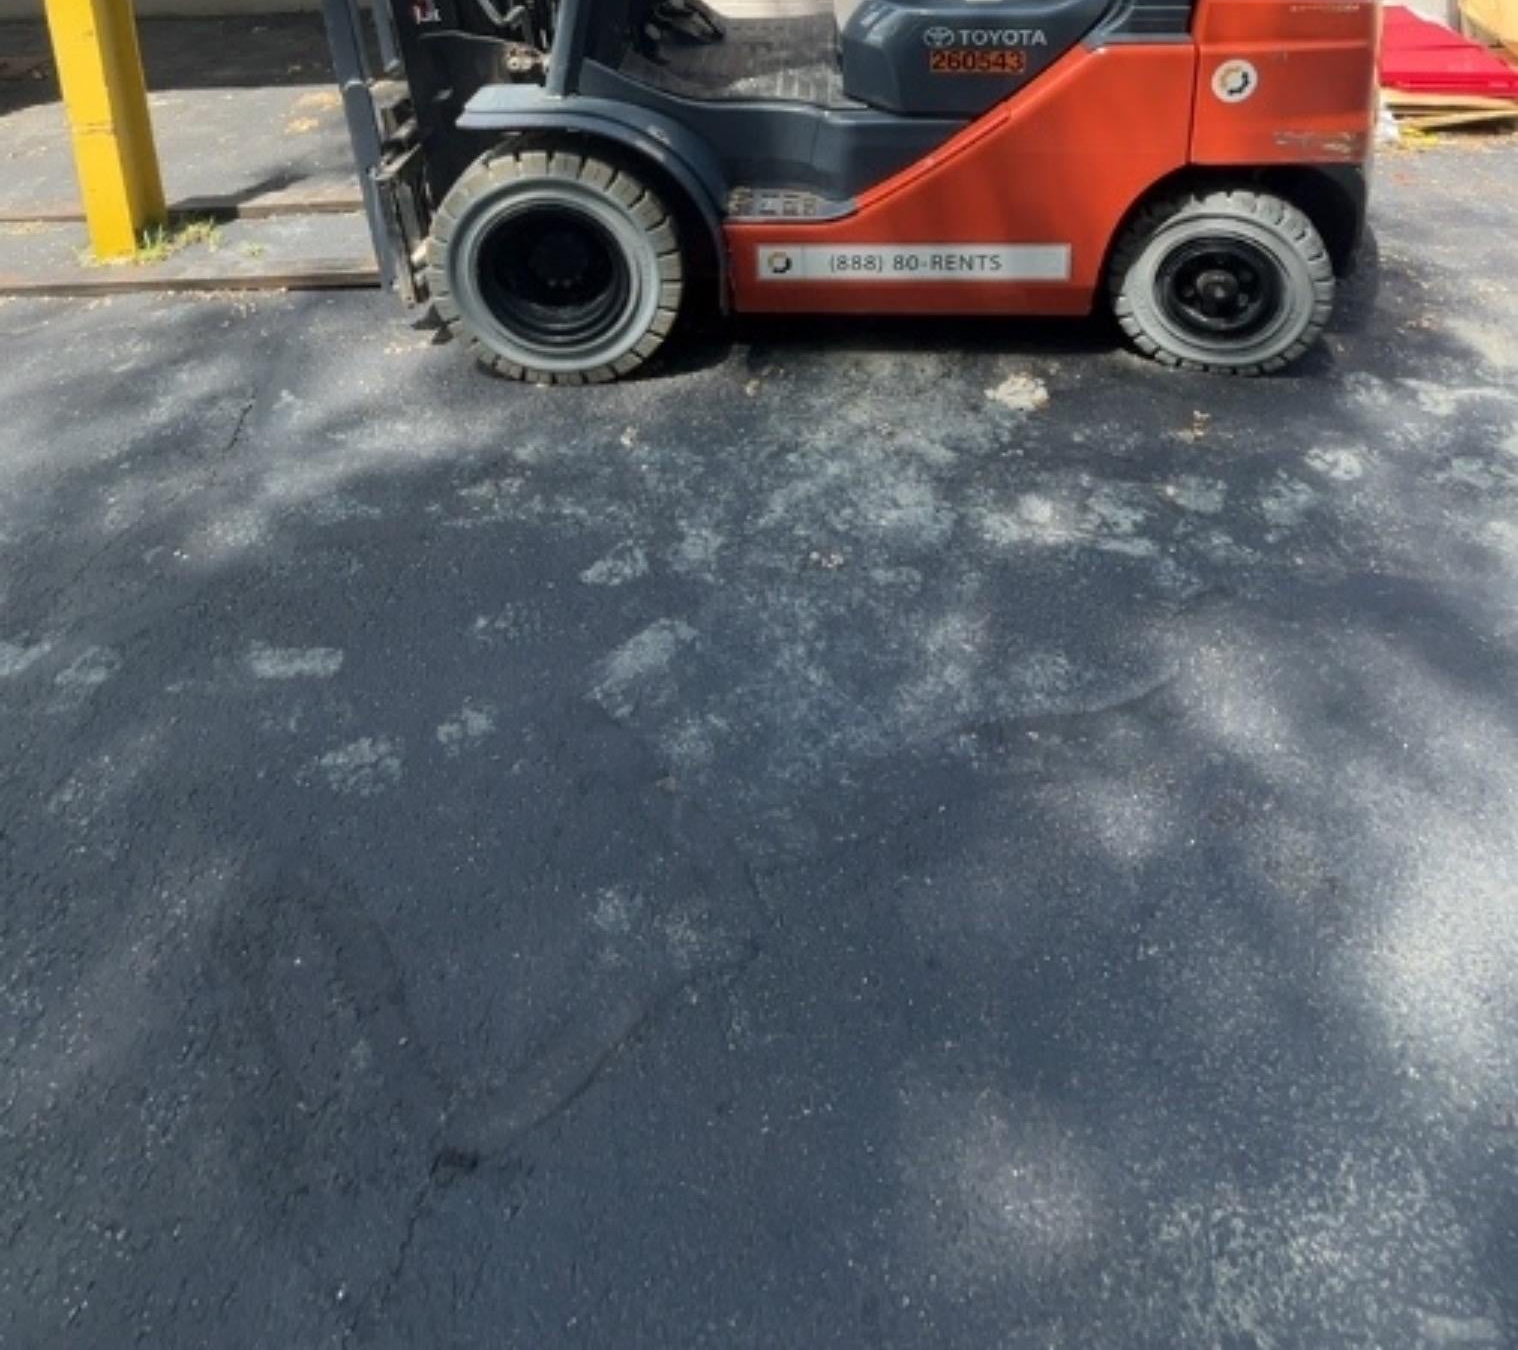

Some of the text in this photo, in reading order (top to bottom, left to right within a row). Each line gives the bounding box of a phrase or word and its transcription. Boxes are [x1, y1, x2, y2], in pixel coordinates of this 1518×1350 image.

[959, 29, 1048, 46] TOYOTA
[931, 50, 1024, 71] 260543
[829, 253, 1003, 272] (888) 80-RENTS
